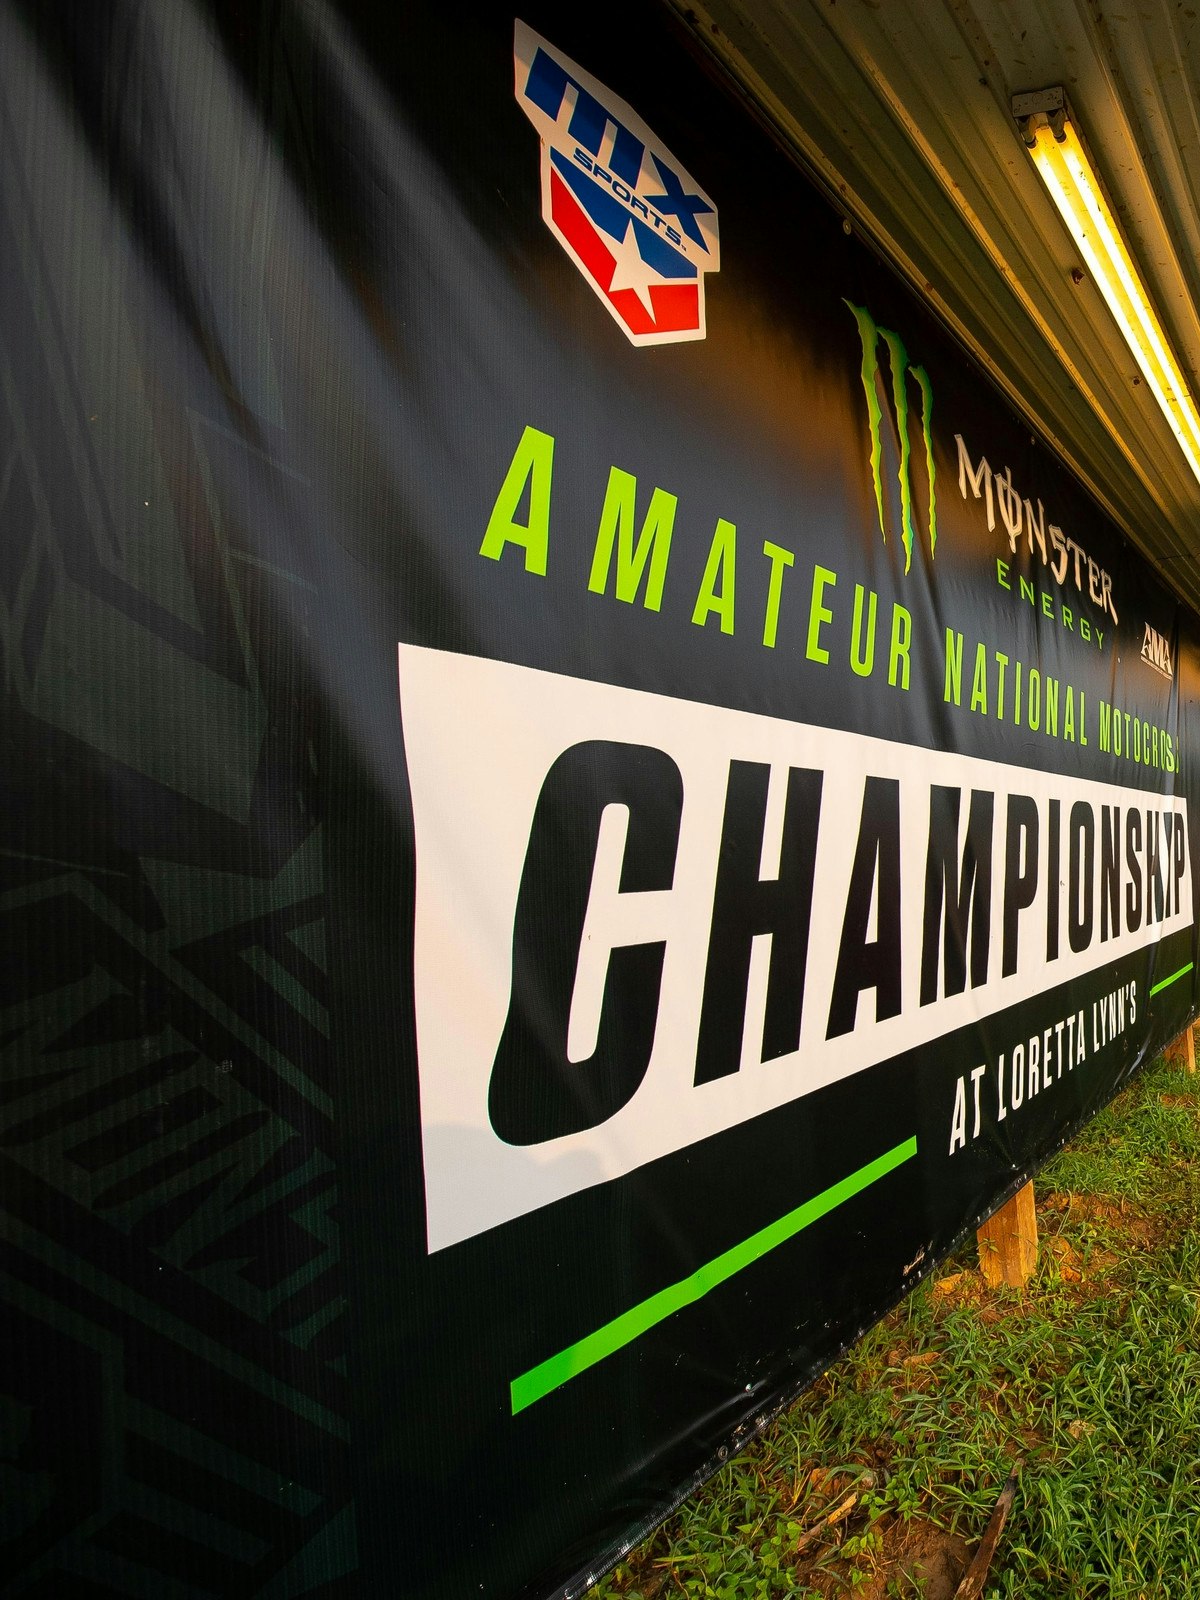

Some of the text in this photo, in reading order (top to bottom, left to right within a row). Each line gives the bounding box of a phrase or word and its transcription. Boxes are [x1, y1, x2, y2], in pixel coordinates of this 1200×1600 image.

[524, 46, 715, 256] MX
[573, 147, 683, 249] SPORTS
[479, 426, 912, 691] AMATEUR
[944, 627, 1087, 746] NATIONAL
[996, 558, 1104, 649] ENERGY
[1140, 621, 1173, 676] AMA
[488, 740, 1185, 1147] CHAMPIONSHIP
[949, 980, 1136, 1156] AT LORETTA LYNN'S
